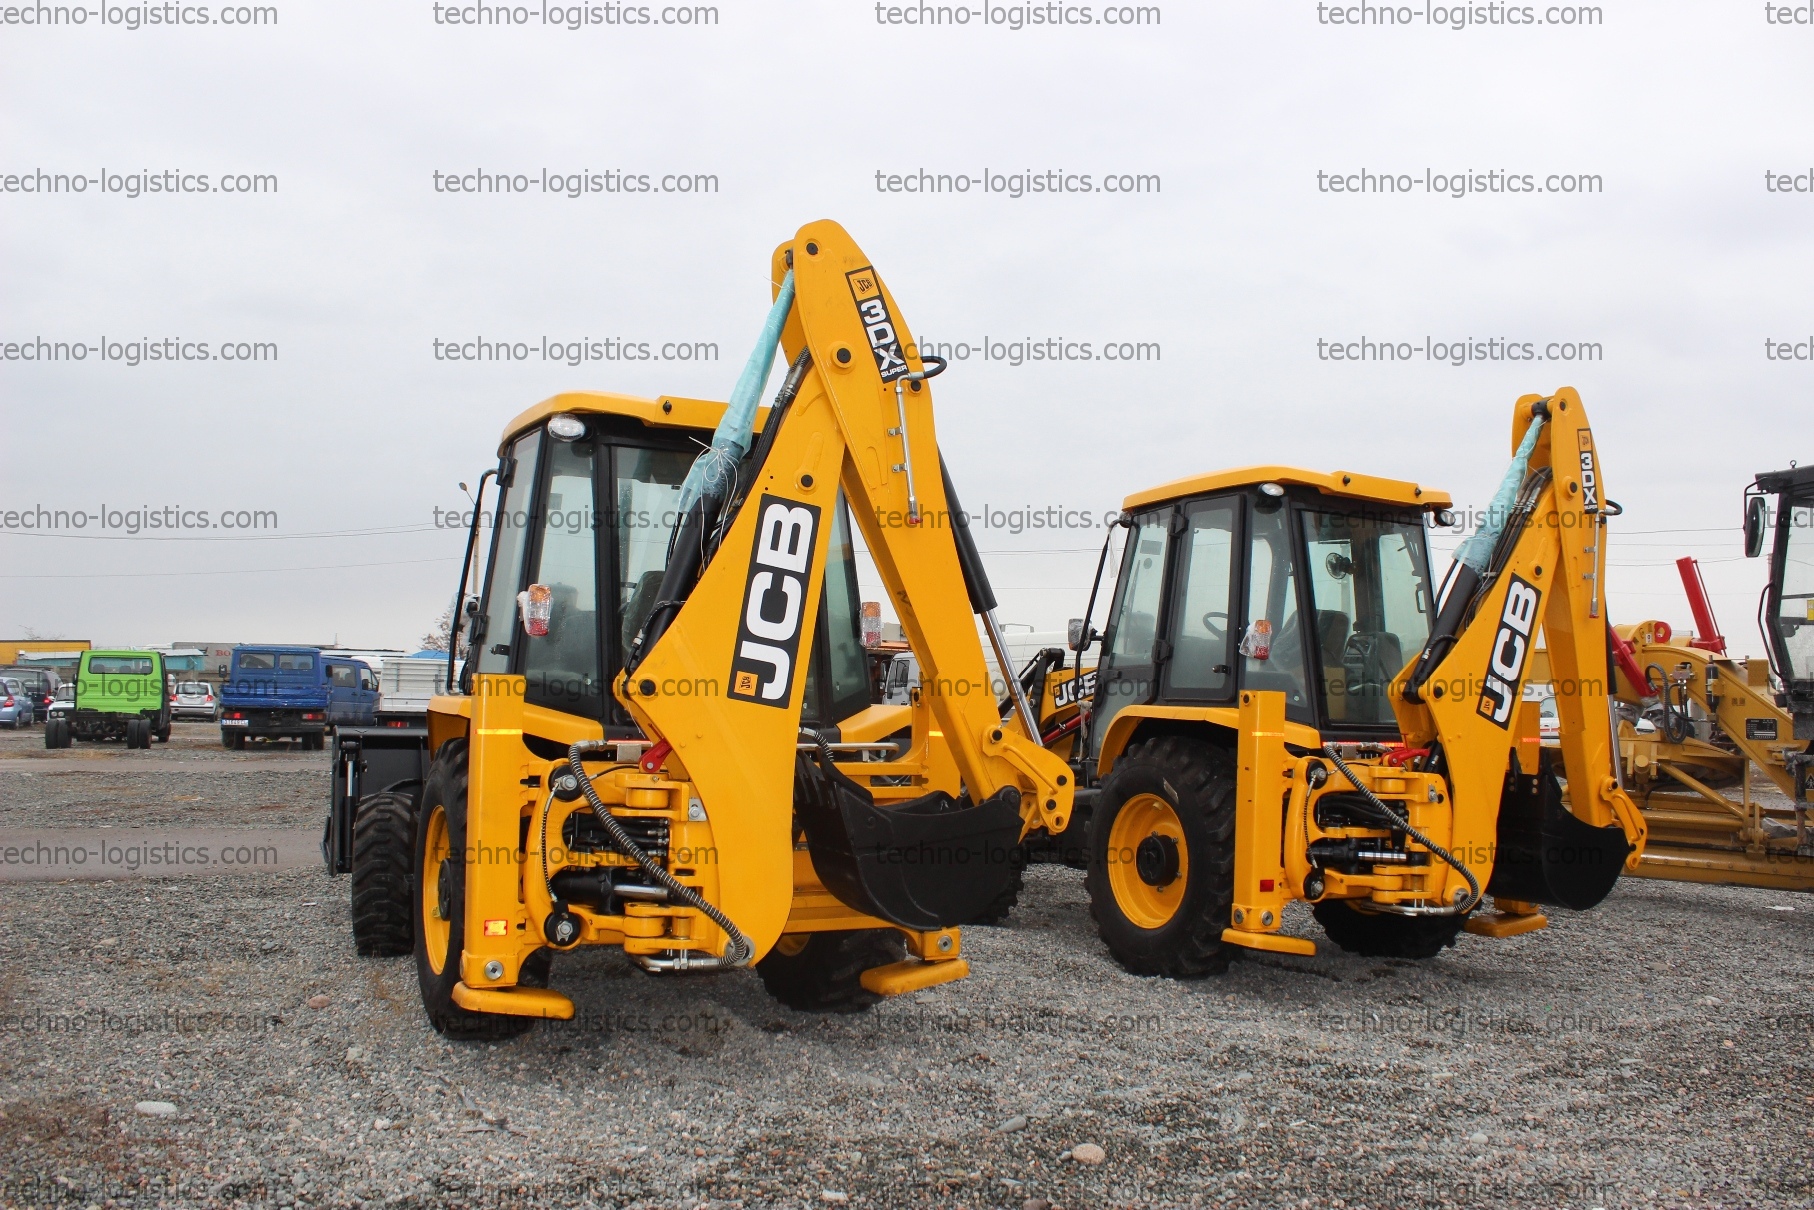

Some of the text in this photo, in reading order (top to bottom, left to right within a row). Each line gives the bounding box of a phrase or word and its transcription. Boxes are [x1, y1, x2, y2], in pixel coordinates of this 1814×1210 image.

[857, 279, 873, 292] JCB
[860, 299, 905, 371] 3DX
[881, 364, 908, 379] SUPER
[1581, 452, 1597, 505] 3DX
[740, 503, 814, 700] JCB
[1485, 581, 1537, 723] JCB
